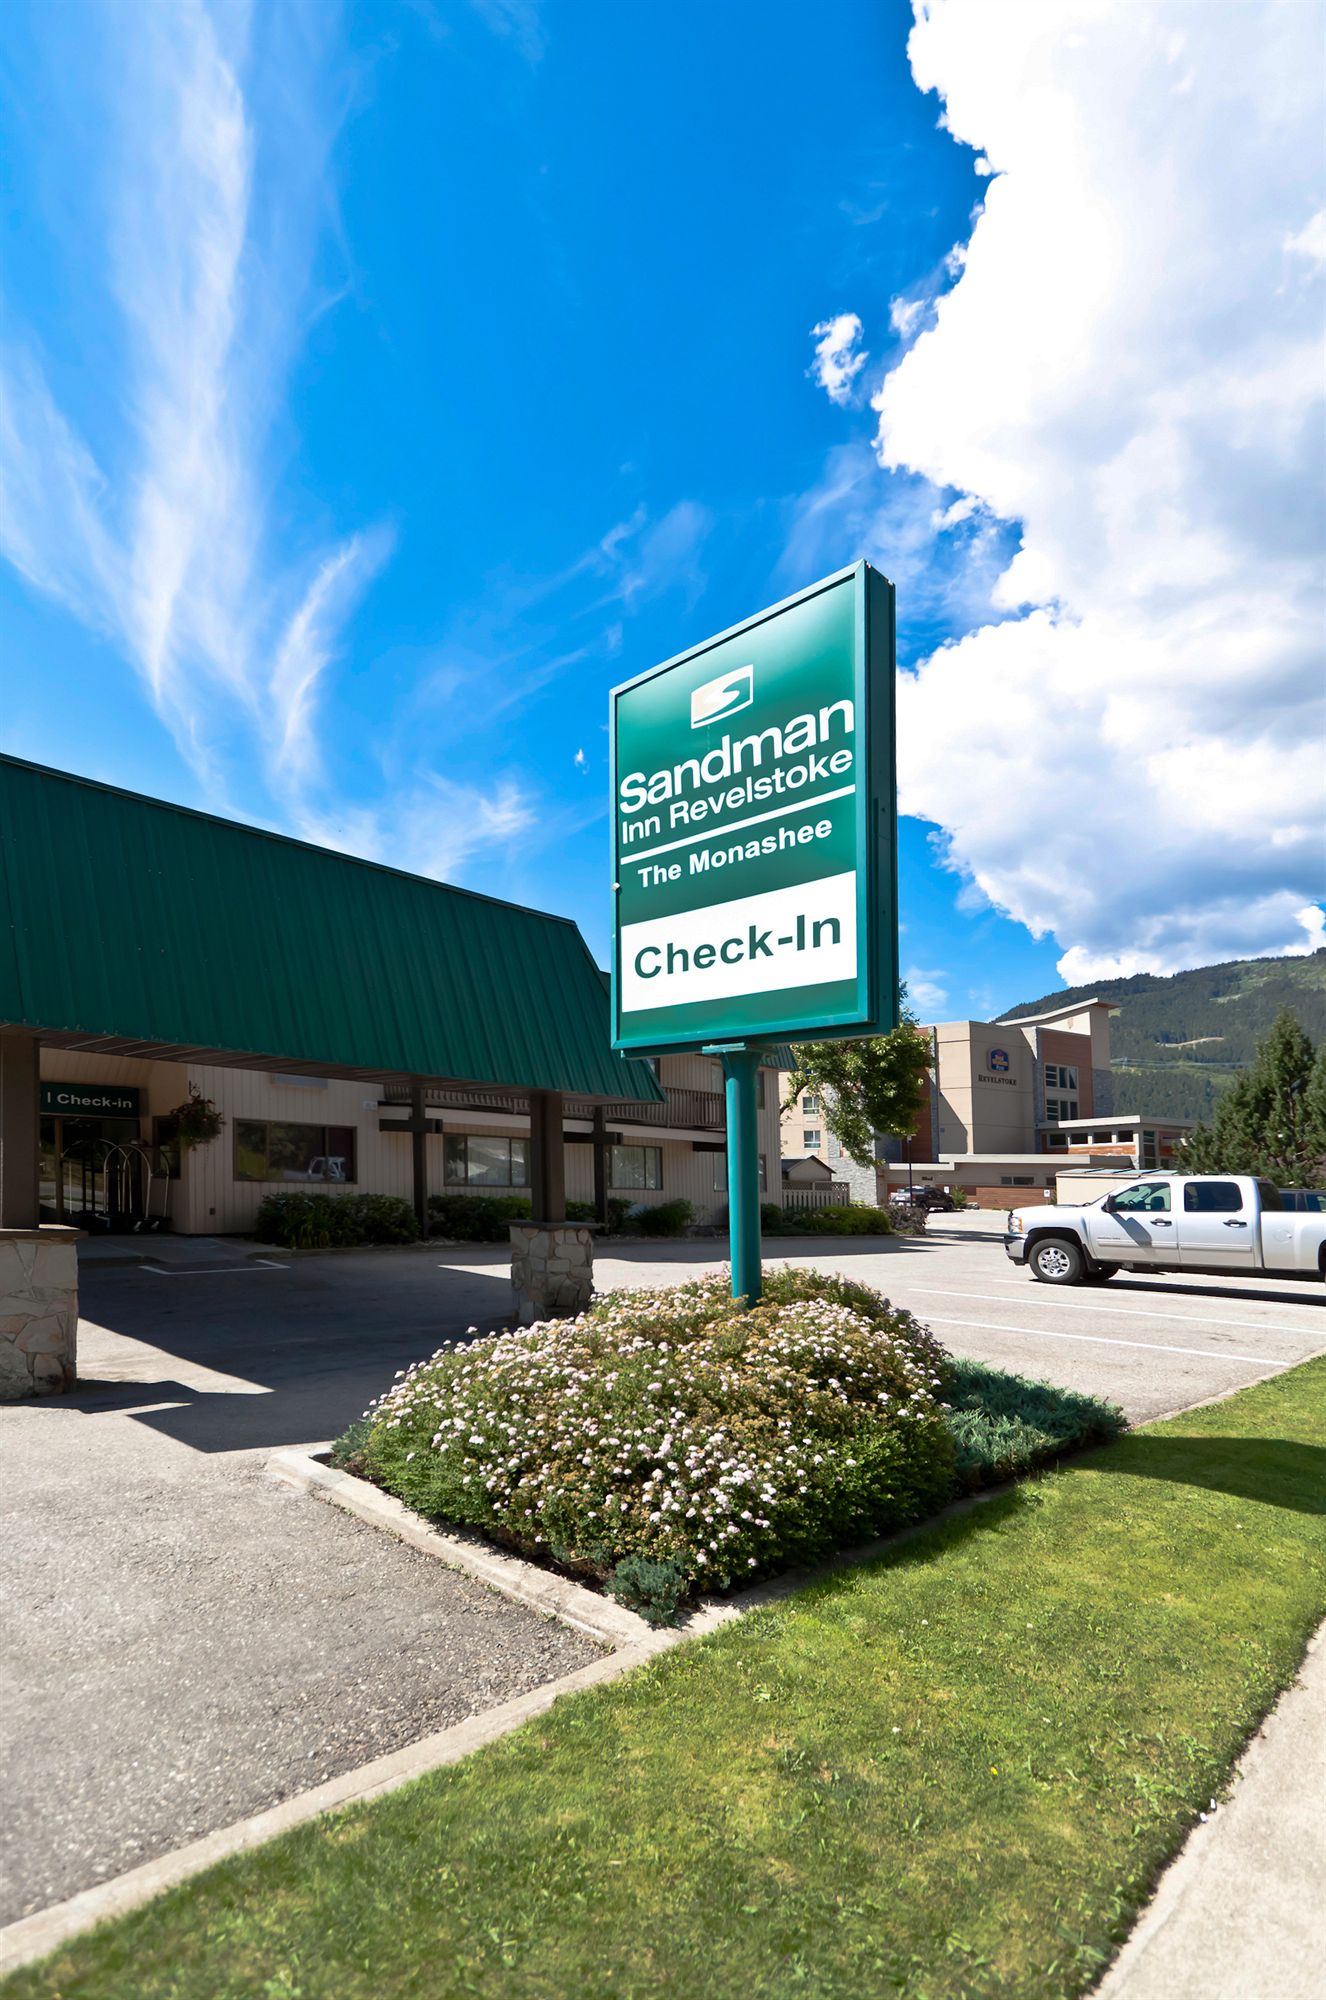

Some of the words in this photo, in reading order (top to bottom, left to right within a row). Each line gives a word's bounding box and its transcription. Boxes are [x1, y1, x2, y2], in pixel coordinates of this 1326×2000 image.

[620, 699, 854, 814] Sandman
[622, 815, 661, 845] Inn
[669, 749, 853, 829] Revelstoke
[637, 864, 682, 888] The
[689, 819, 833, 875] Monashee
[634, 914, 841, 979] Check-In
[56, 1093, 132, 1108] Check-in
